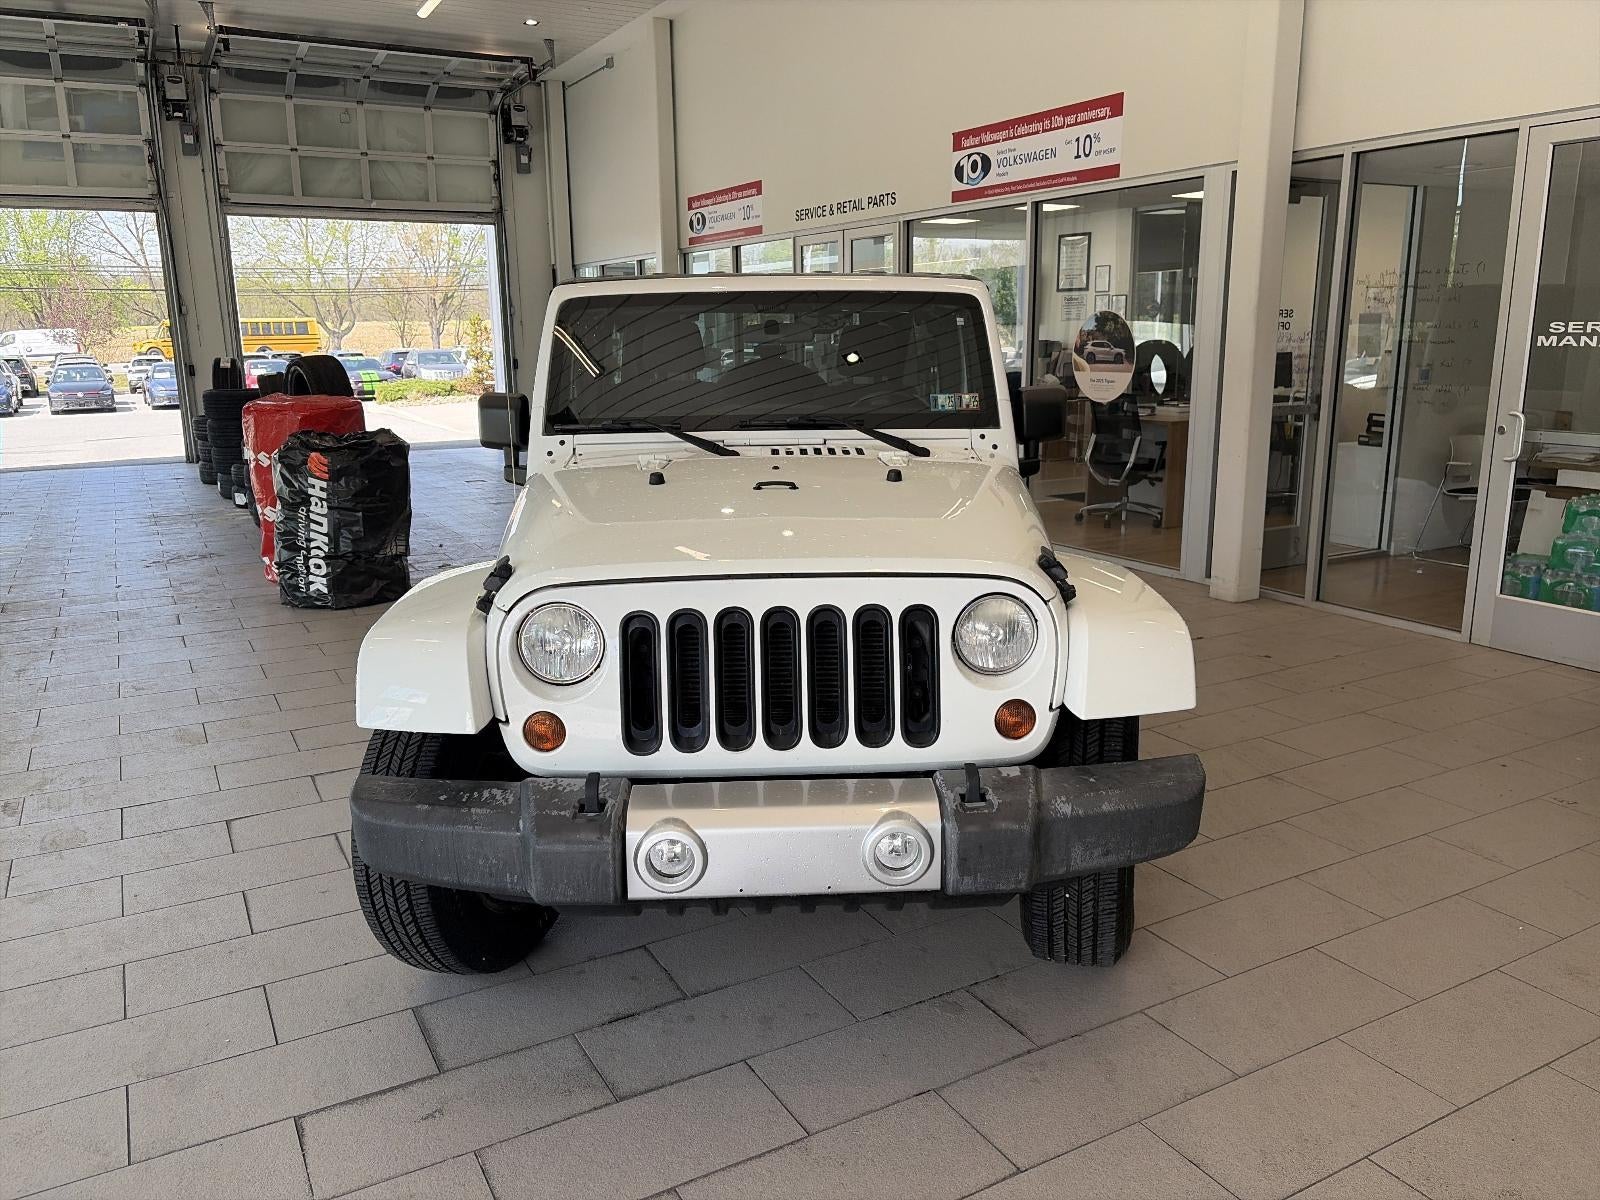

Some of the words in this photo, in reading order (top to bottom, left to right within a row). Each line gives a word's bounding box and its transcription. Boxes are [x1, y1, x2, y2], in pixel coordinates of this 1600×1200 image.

[961, 134, 980, 148] Faulkner
[980, 129, 1009, 143] Volkswagen
[1009, 126, 1014, 137] is
[1014, 118, 1042, 136] Celebrating
[1051, 114, 1064, 128] 10th
[1064, 111, 1077, 128] year
[1077, 105, 1112, 123] anniversary.
[996, 146, 1057, 169] VOLKSWAGEN
[794, 204, 827, 222] SERVICE
[828, 203, 835, 216] &
[836, 197, 866, 215] RETAIL
[867, 191, 897, 210] PARTS
[1549, 321, 1600, 333] SER
[1537, 335, 1600, 347] MAN
[296, 506, 308, 548] driving
